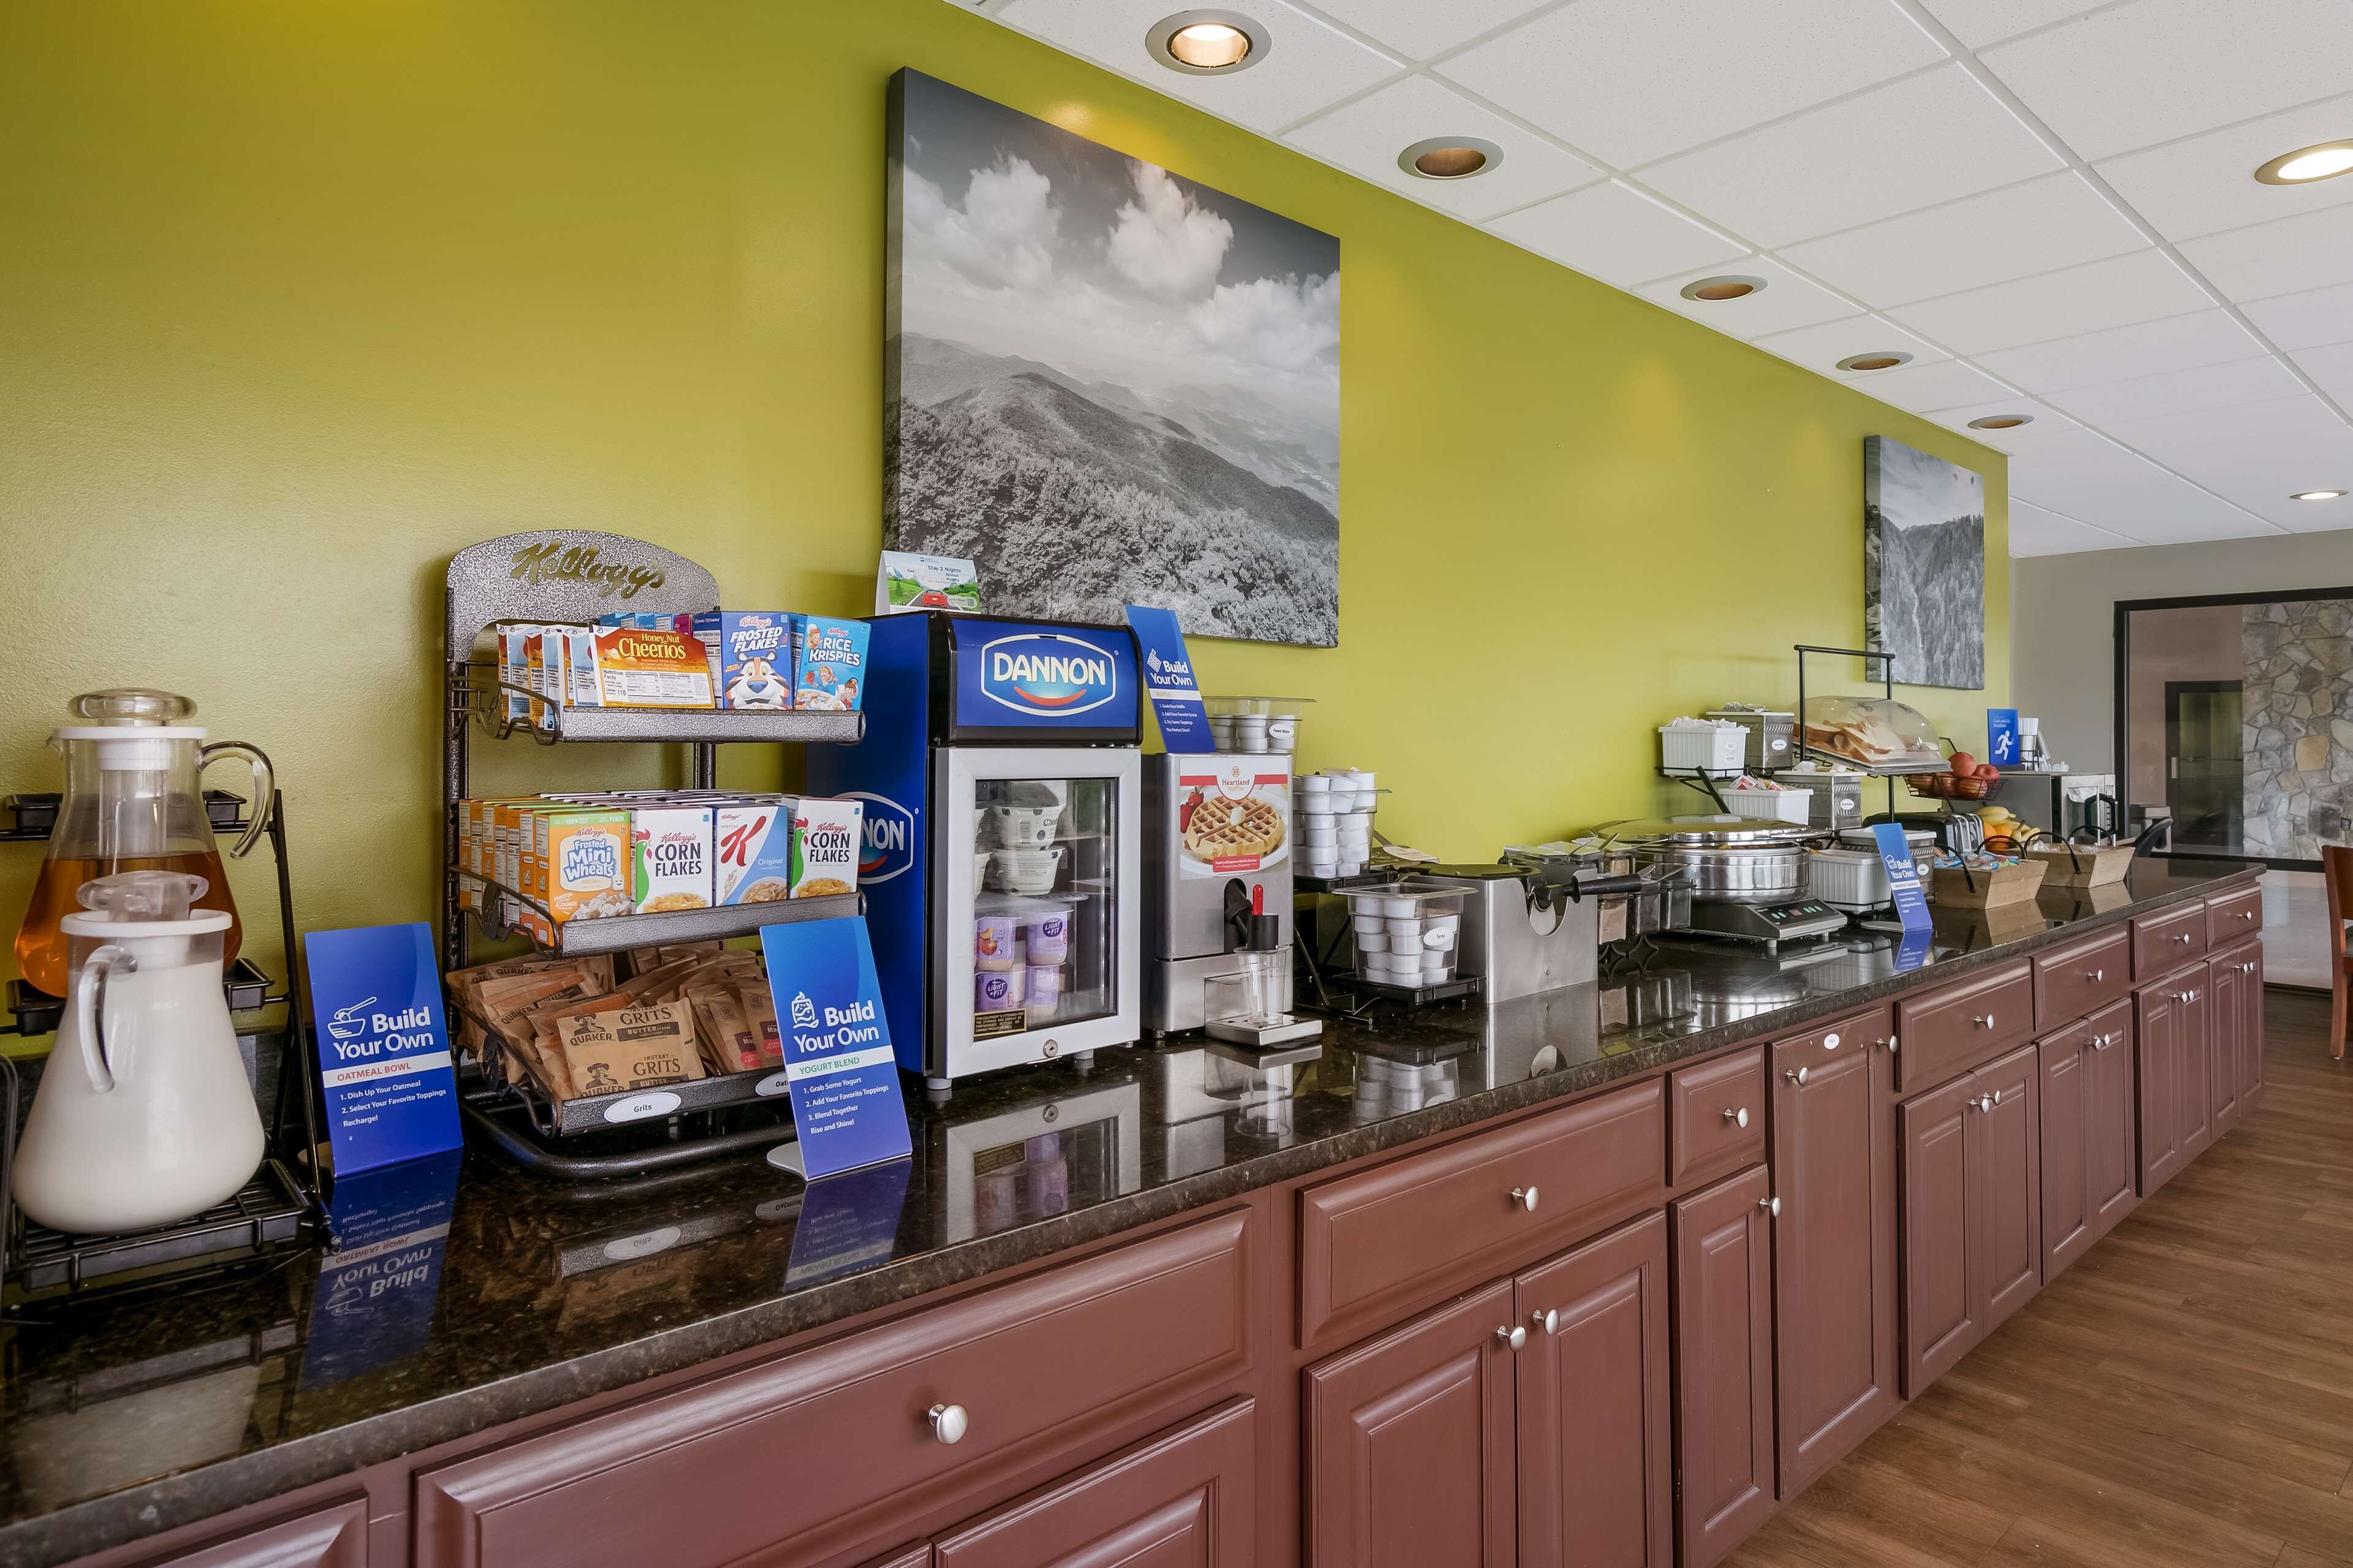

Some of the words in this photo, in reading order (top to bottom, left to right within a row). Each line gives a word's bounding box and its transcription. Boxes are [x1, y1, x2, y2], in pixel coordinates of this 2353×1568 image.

[510, 539, 667, 599] Kellogg's
[739, 615, 772, 629] Kellogg's
[642, 634, 664, 644] Honey
[730, 626, 783, 643] FROSTED
[618, 638, 686, 659] Cheerios
[733, 637, 778, 653] FLAKES
[823, 637, 852, 651] RICE
[809, 648, 861, 666] KRISPIES
[993, 652, 1106, 686] DANNON
[1162, 660, 1189, 674] Build
[1150, 672, 1171, 685] Your
[1171, 674, 1193, 686] Own
[576, 827, 607, 837] Kellogg's
[816, 822, 848, 834] Kellogg's
[574, 839, 606, 850] Frosted
[661, 832, 696, 844] Kellogg's
[721, 816, 767, 867] K
[810, 832, 850, 849] CORN
[568, 847, 612, 867] Mini
[655, 843, 701, 861] CORN
[810, 849, 850, 863] FLAKES
[564, 860, 614, 881] Wheats
[655, 861, 702, 877] FLAKES
[1896, 859, 1912, 869] Build
[1890, 870, 1903, 879] Your
[1903, 869, 1915, 878] Own
[371, 1006, 431, 1034] Build
[620, 1007, 672, 1025] GRITS
[824, 1000, 875, 1028] Build
[628, 1026, 656, 1035] BUTTER
[333, 1039, 382, 1061] Your
[384, 1031, 434, 1052] Own
[569, 1033, 613, 1047] QUAKER
[794, 1033, 837, 1053] Your
[837, 1026, 880, 1047] Own
[337, 1067, 382, 1081] OATMEAL
[384, 1062, 412, 1074] BOWL
[633, 1059, 681, 1077] GRITS
[799, 1061, 833, 1075] YOGURT
[834, 1056, 859, 1070] BLEND
[348, 1090, 363, 1100] Dish
[365, 1089, 374, 1097] Up
[375, 1086, 392, 1095] Your
[392, 1080, 421, 1093] Oatmeal
[810, 1084, 824, 1094] Grab
[825, 1081, 841, 1091] Some
[842, 1076, 862, 1089] Yogurt
[349, 1103, 371, 1113] Select
[371, 1099, 387, 1109] Your
[388, 1094, 416, 1105] Favorite
[416, 1088, 447, 1101] Toppings
[812, 1097, 824, 1107] Add
[825, 1094, 838, 1104] Your
[839, 1089, 862, 1101] Favorite
[862, 1085, 889, 1099] Toppings
[634, 1104, 652, 1113] Grits
[815, 1110, 832, 1120] Blend
[832, 1104, 859, 1118] Together
[343, 1114, 378, 1127] Recharge!
[810, 1126, 823, 1135] Rise
[824, 1123, 836, 1132] and
[836, 1118, 854, 1129] Shine!
